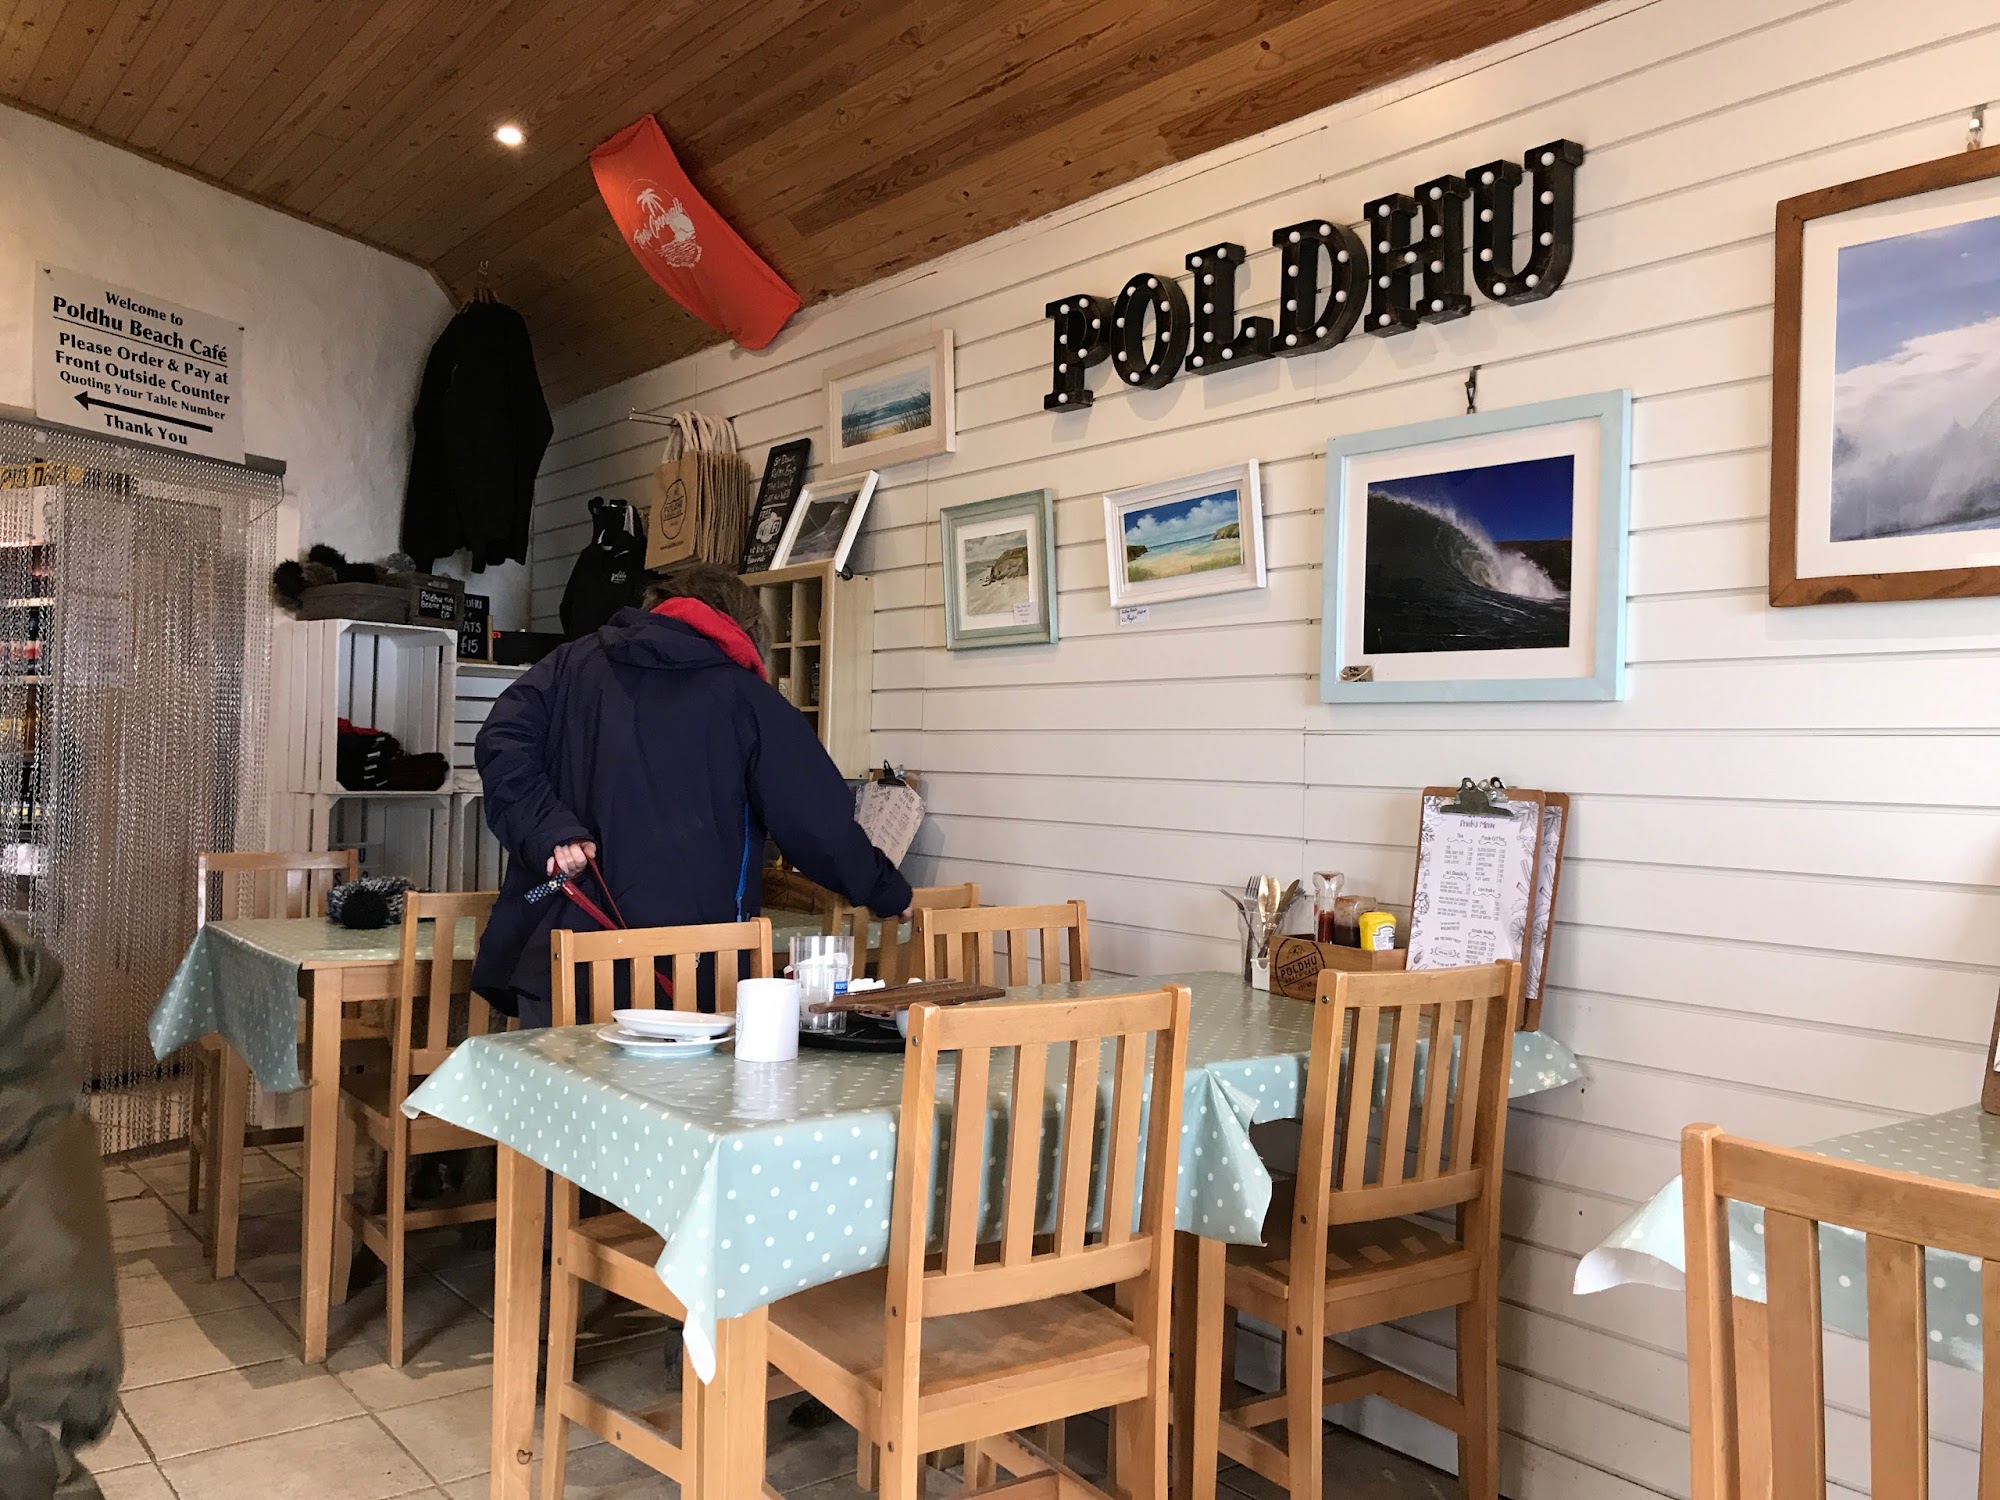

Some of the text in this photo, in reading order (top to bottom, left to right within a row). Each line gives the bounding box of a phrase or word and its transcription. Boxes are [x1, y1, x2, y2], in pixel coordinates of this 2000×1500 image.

[1044, 138, 1583, 412] POLDHU
[53, 295, 228, 362] Poldhu Beach Café
[105, 291, 184, 326] Welcome to
[55, 349, 231, 404] Front Outside Counter
[59, 332, 229, 385] Please Order & Pay at
[60, 370, 226, 420] Quoting Your Table Number
[103, 413, 188, 445] Thank You
[460, 635, 479, 655] £15
[463, 621, 482, 634] ATS
[1280, 955, 1318, 979] POLDHU
